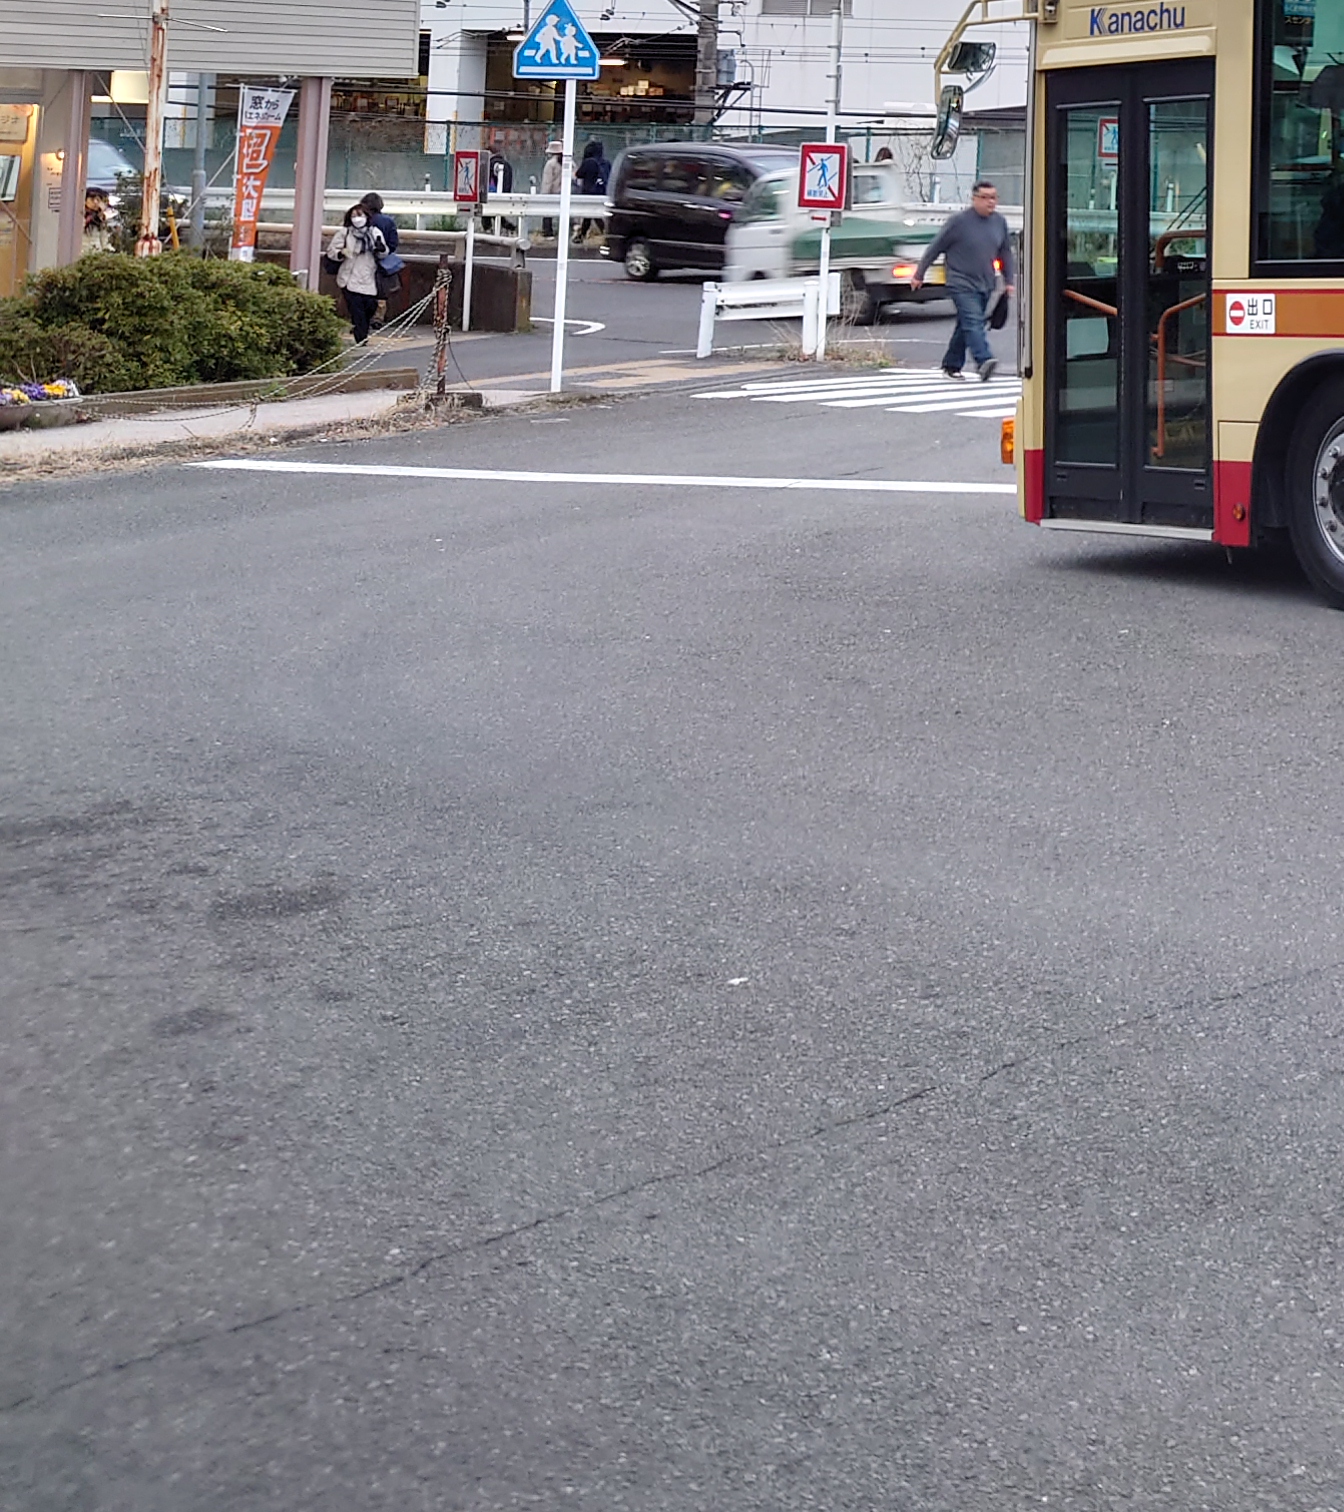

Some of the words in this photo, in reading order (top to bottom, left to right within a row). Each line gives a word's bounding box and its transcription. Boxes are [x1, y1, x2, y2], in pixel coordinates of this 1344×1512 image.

[1089, 1, 1186, 36] Kanachu
[1247, 297, 1273, 316] 出口
[1249, 319, 1269, 330] EXIT
